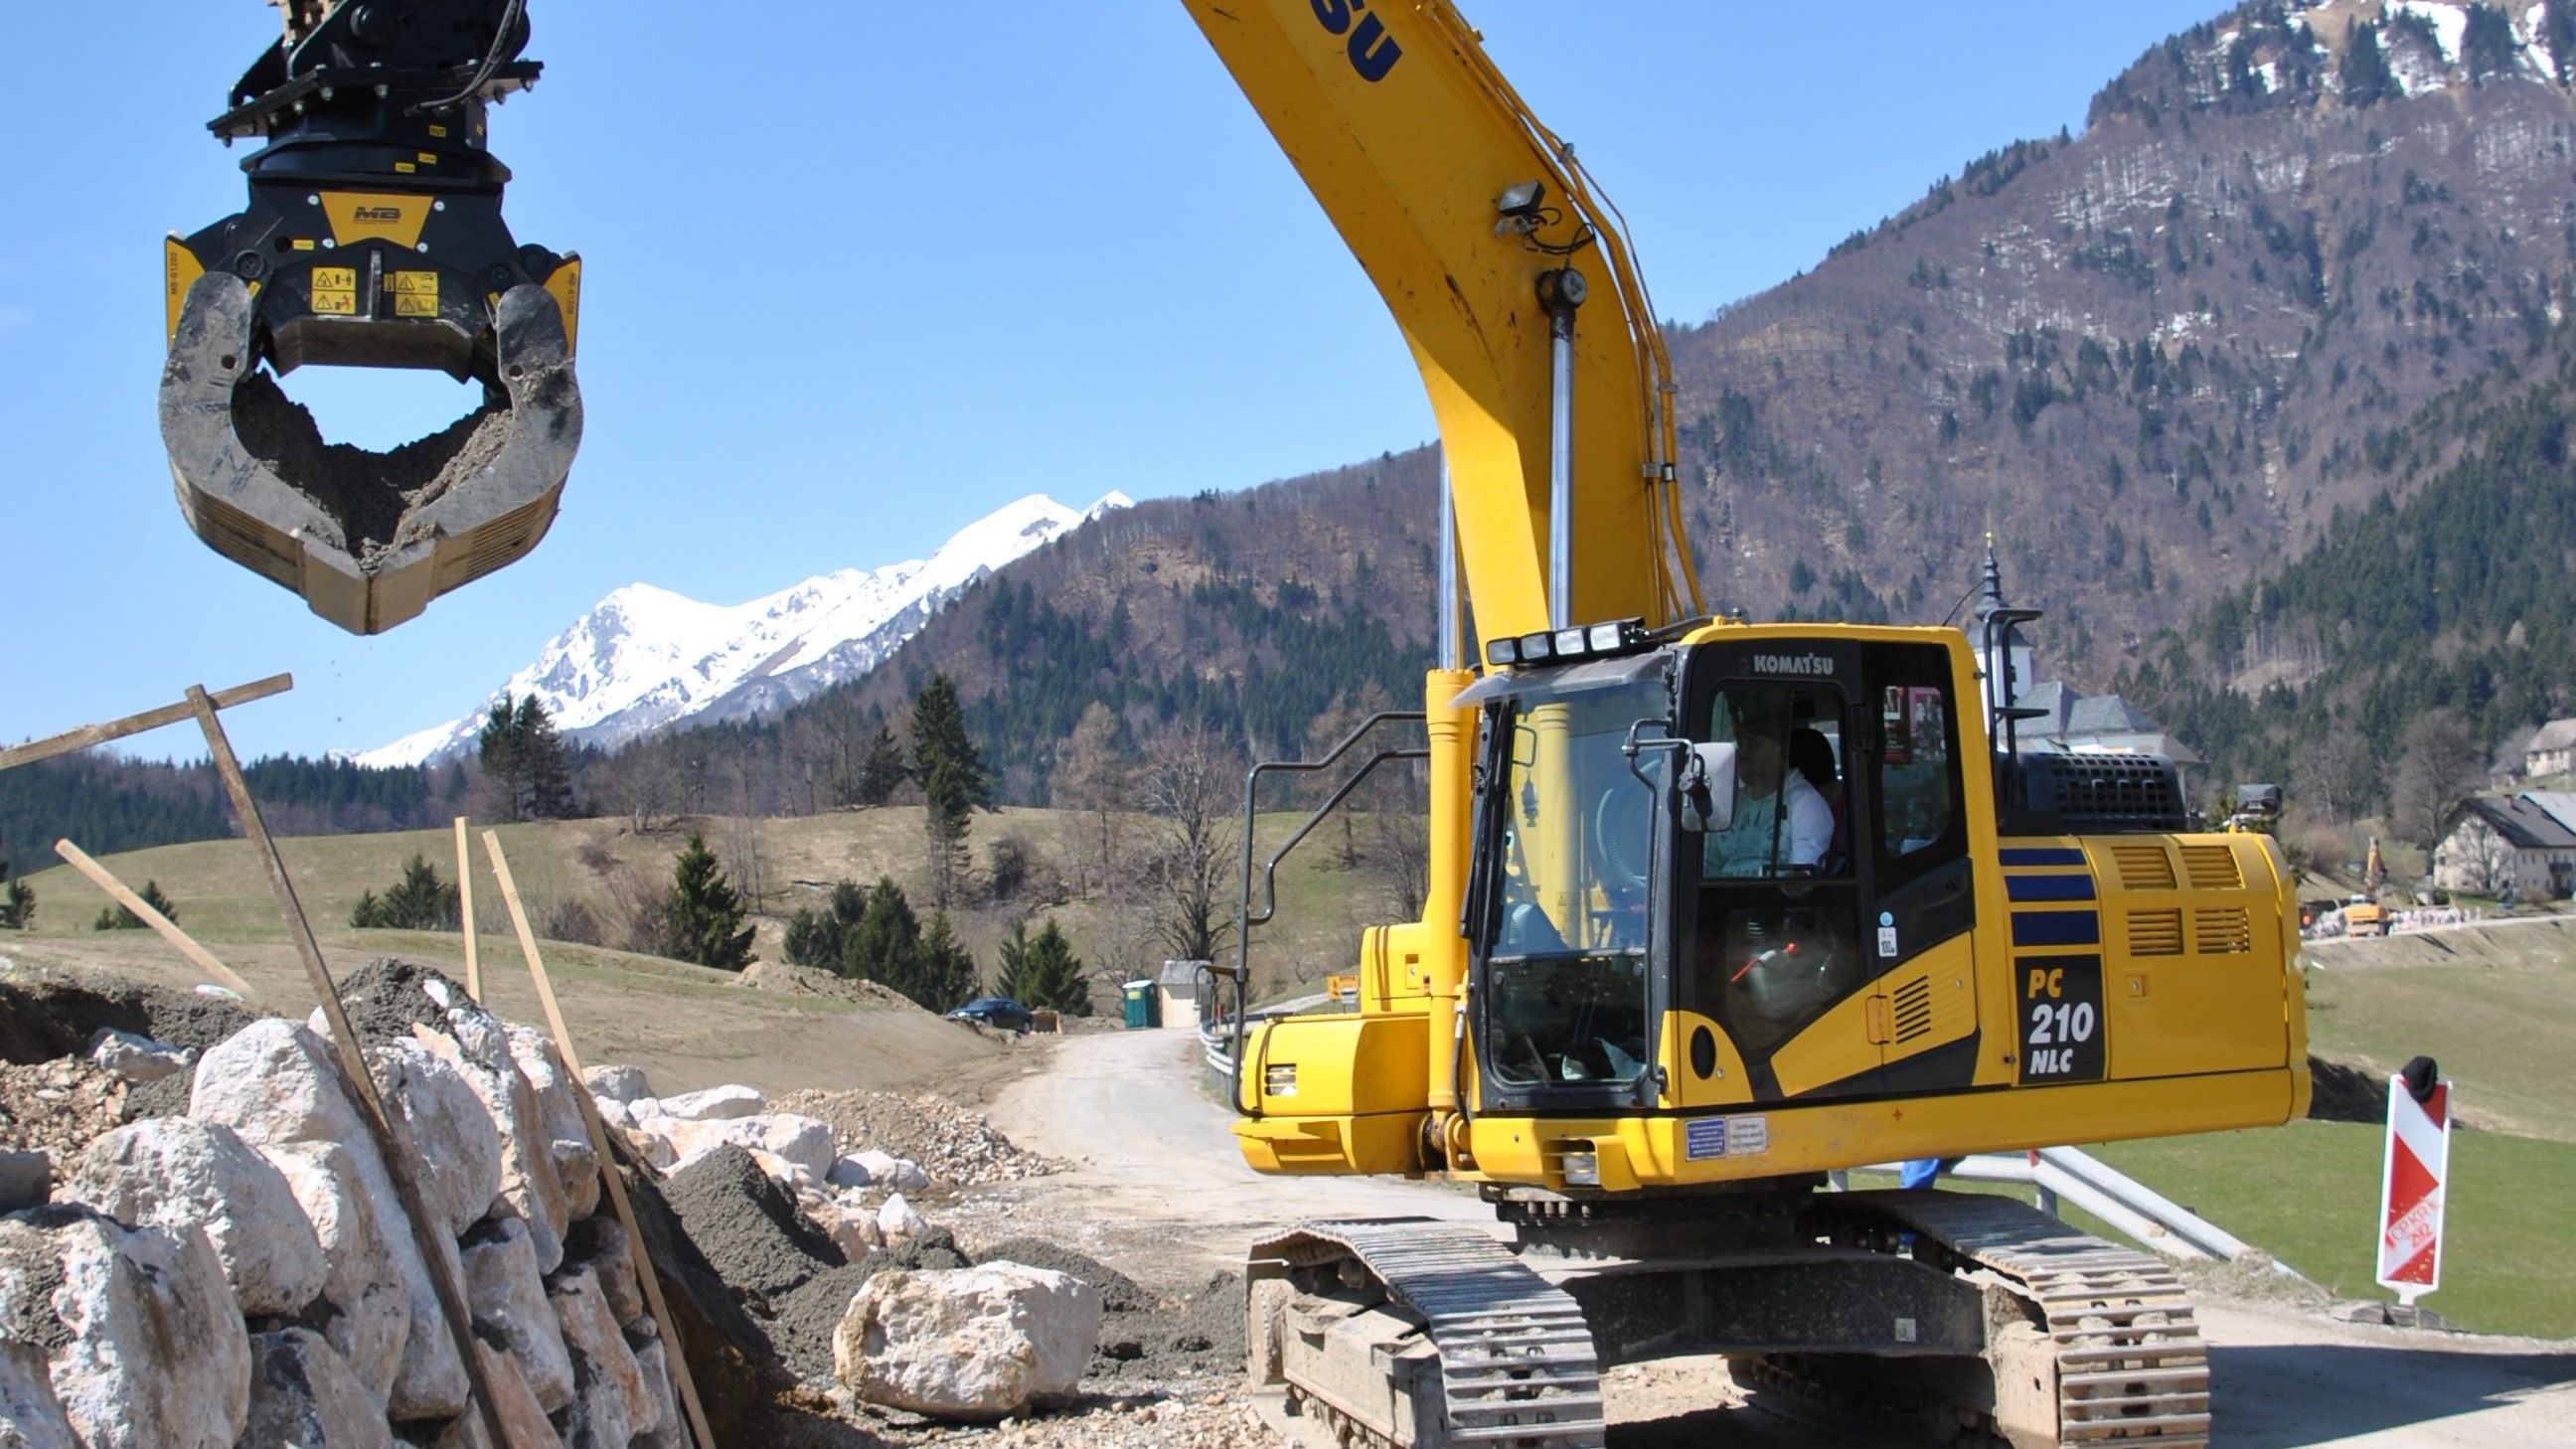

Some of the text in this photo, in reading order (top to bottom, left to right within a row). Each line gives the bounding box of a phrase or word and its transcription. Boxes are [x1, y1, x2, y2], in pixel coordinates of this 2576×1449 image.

[1753, 652, 1834, 676] KOMATSU
[2028, 968, 2063, 999] PC
[2028, 1002, 2094, 1045] 210
[2029, 1048, 2074, 1074] NLC
